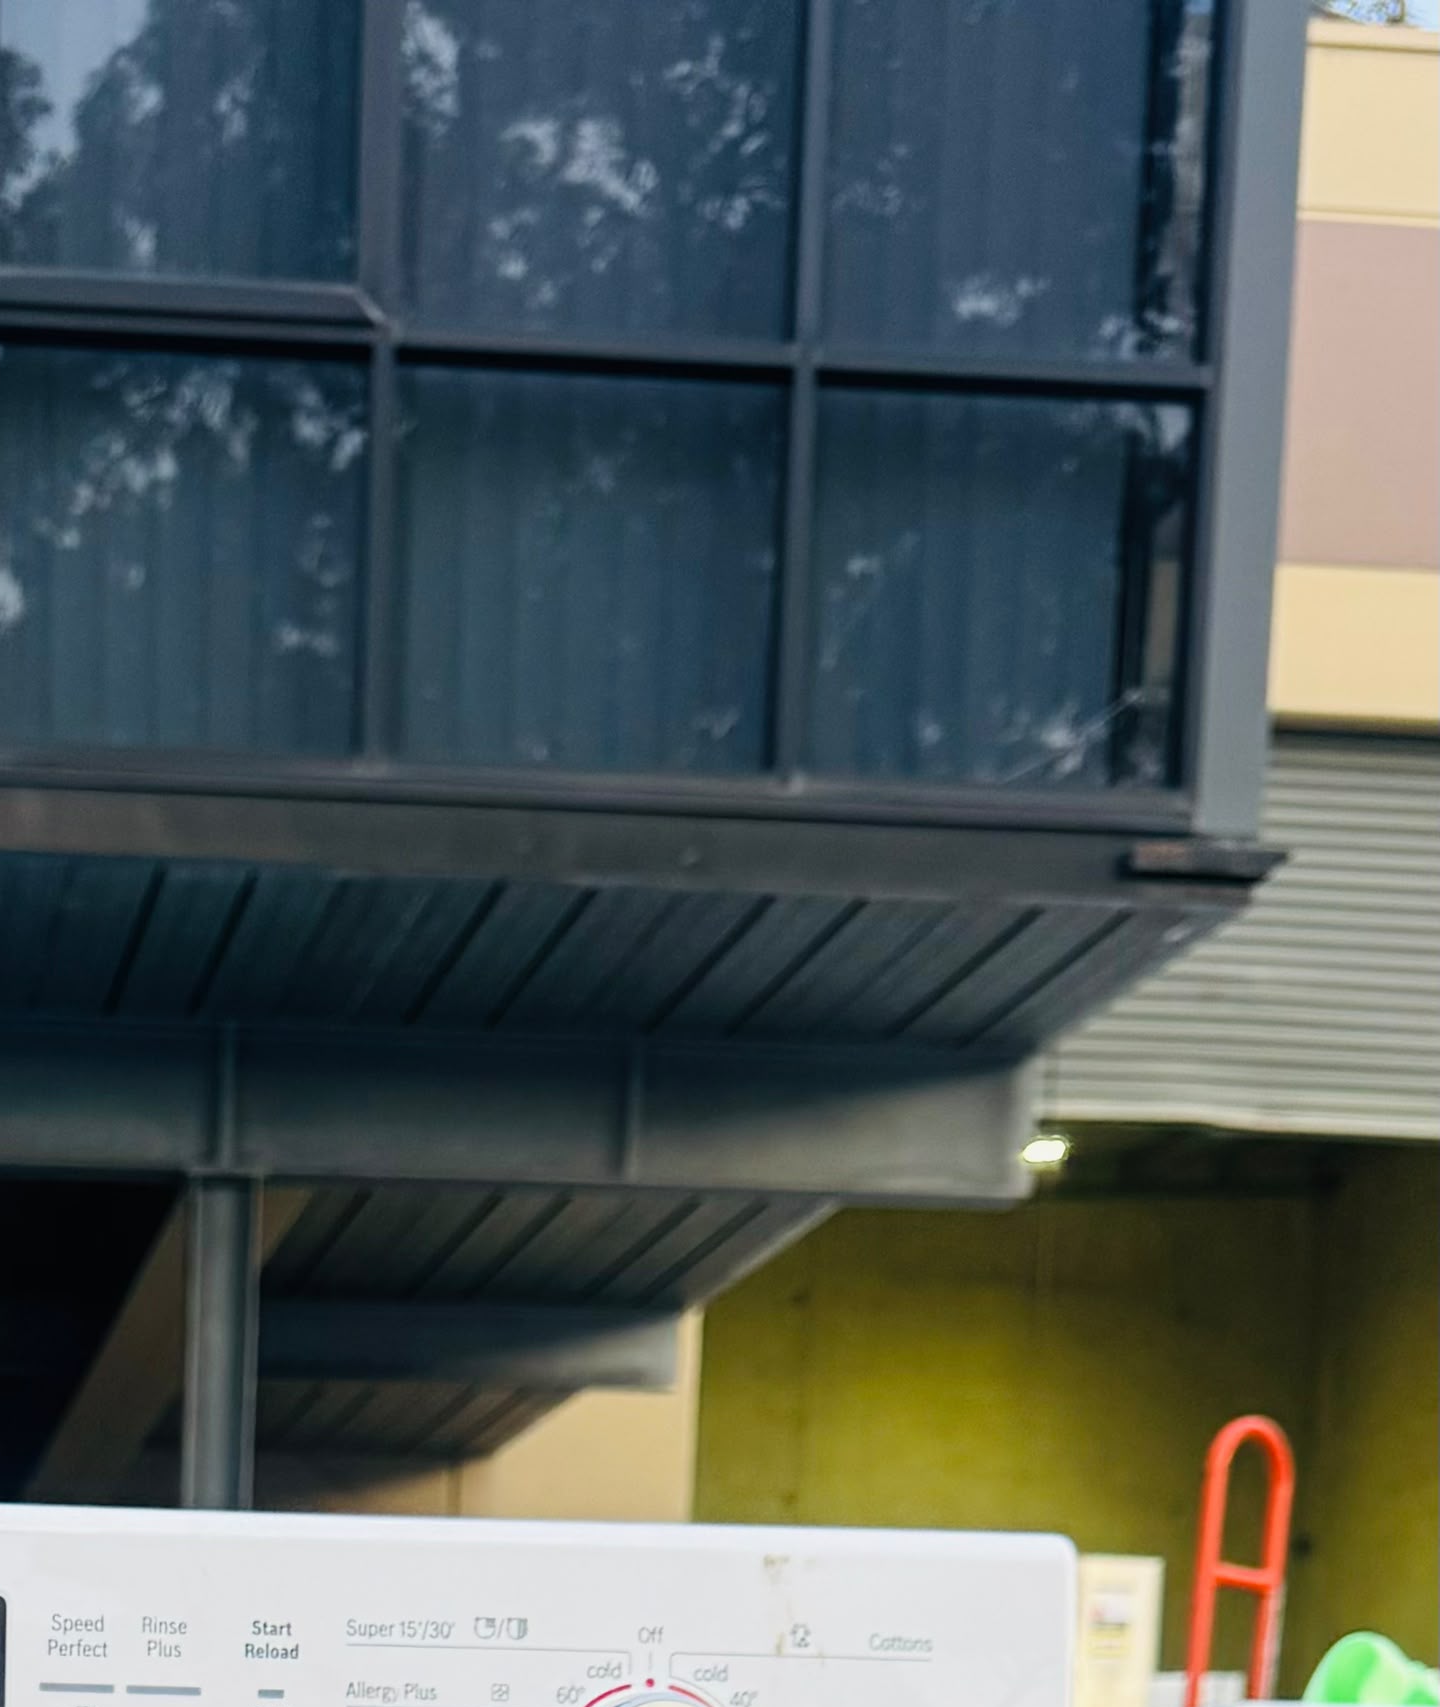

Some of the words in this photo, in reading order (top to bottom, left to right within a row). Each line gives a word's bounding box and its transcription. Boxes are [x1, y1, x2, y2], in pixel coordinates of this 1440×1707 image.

[51, 1613, 105, 1635] Speed
[142, 1616, 188, 1635] Rinse
[252, 1620, 292, 1636] Start
[346, 1619, 395, 1639] Super
[638, 1626, 664, 1644] Off
[868, 1633, 933, 1652] Cottons
[48, 1639, 108, 1659] Perfect
[147, 1640, 182, 1659] Plus
[245, 1643, 300, 1660] Reload
[586, 1662, 622, 1680] cold
[693, 1664, 729, 1682] cold
[346, 1682, 399, 1703] Allergy
[404, 1683, 438, 1701] Plus
